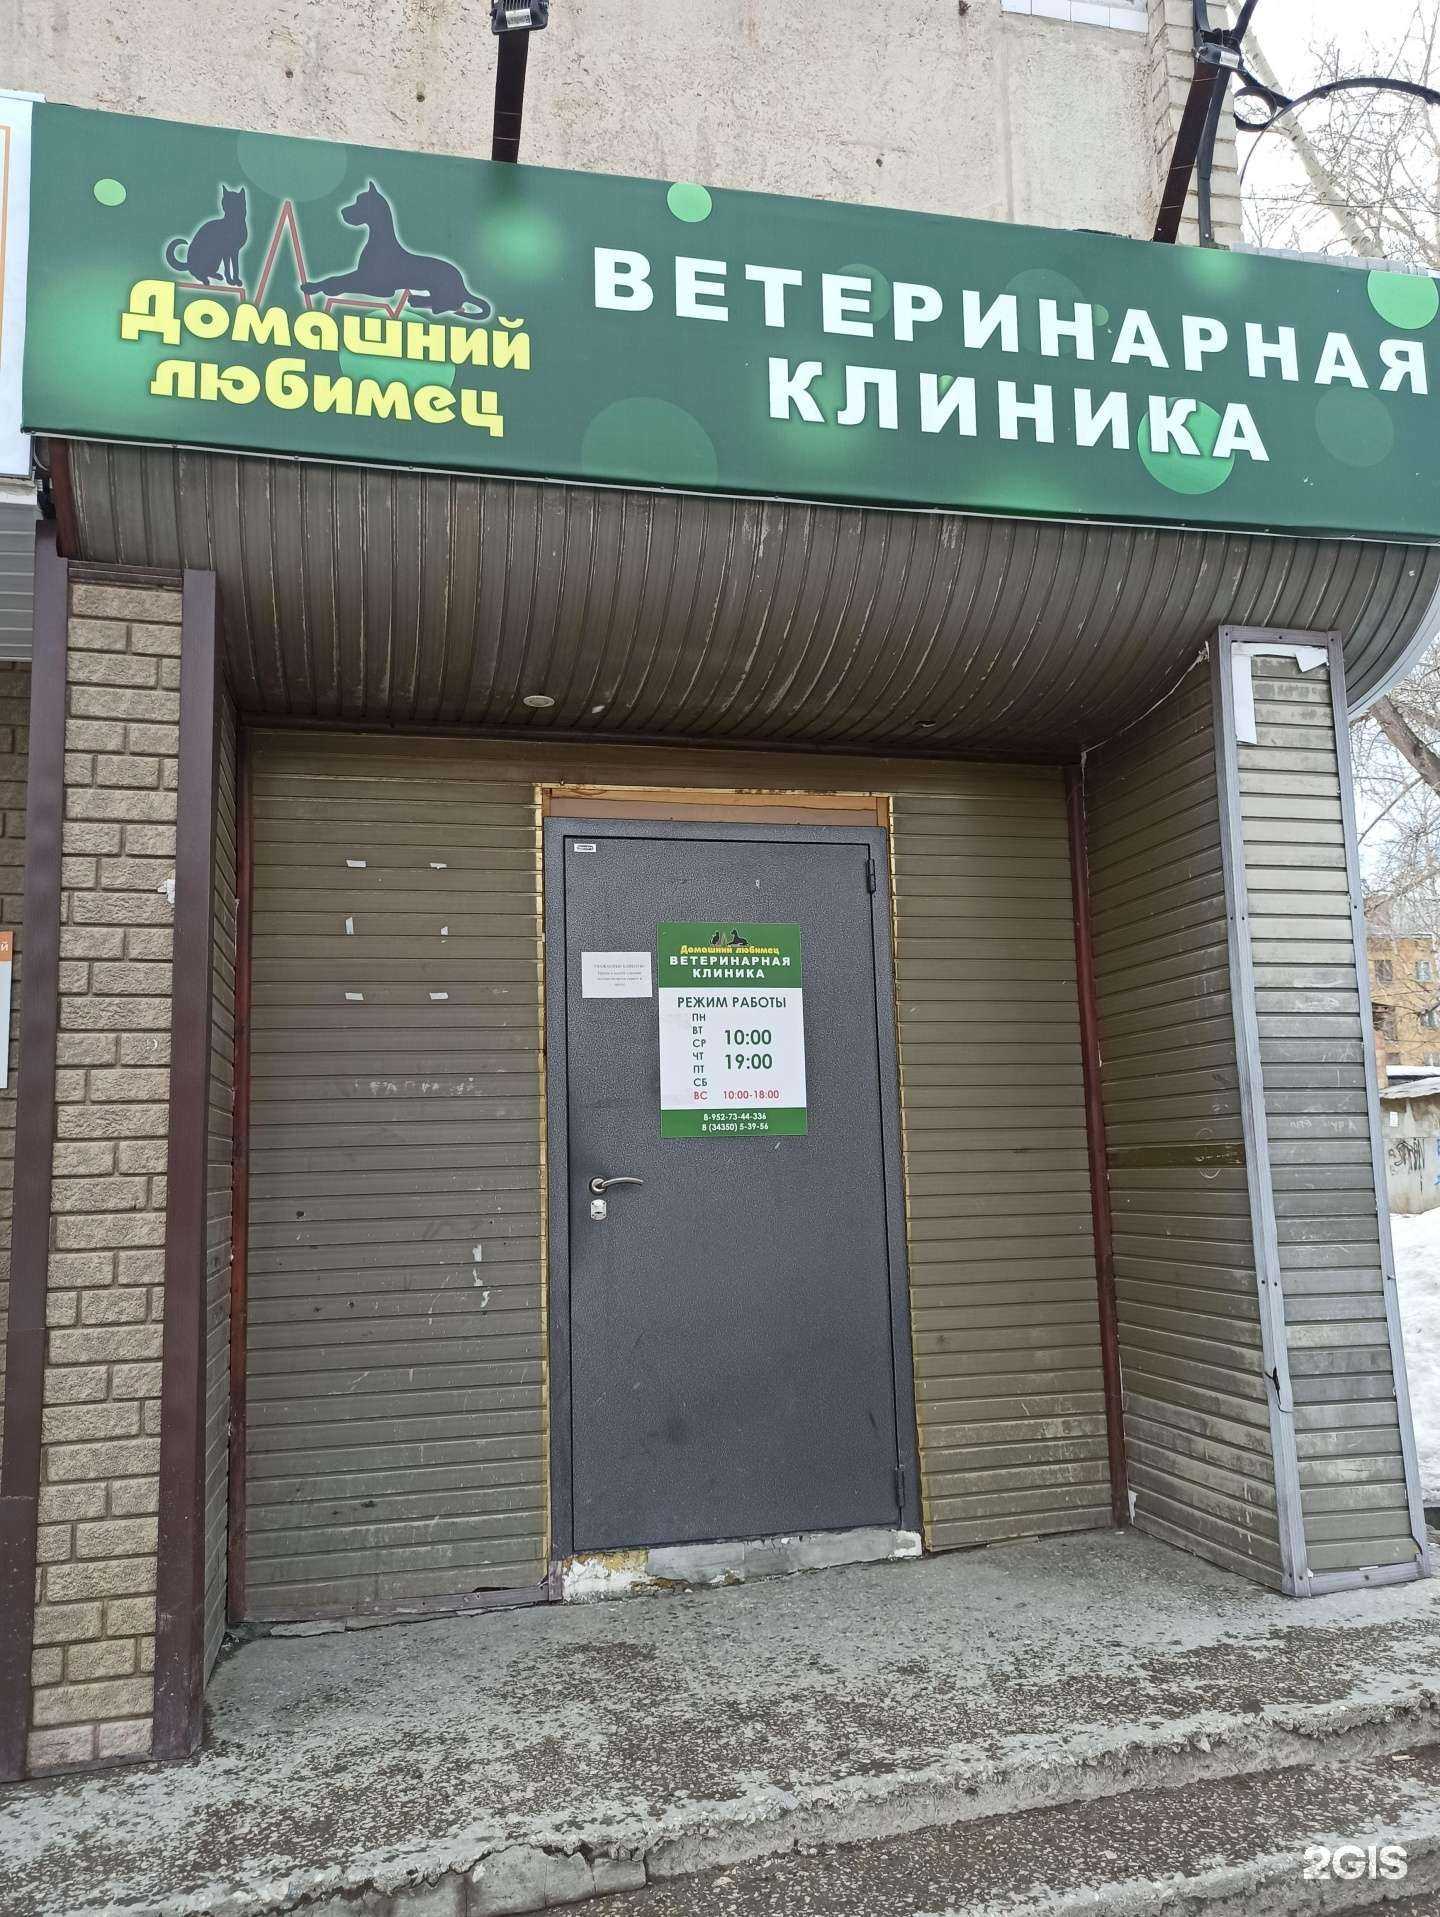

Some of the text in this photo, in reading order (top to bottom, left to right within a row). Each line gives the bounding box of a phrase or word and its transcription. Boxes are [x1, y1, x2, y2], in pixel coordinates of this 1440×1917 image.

[120, 279, 531, 371] Домашний
[593, 246, 1428, 395] ВЕТЕРИНАРНАЯ
[150, 356, 504, 437] любимец
[767, 356, 1270, 463] КЛИНИКА
[680, 945, 780, 955] Домашний любимец
[669, 956, 791, 966] ВЕТЕРИНАРНАЯ
[692, 968, 765, 978] КЛИНИКА
[677, 997, 786, 1008] РЕЖИМ РАБОТЫ
[692, 1013, 706, 1022] ПН
[692, 1026, 703, 1035] ВТ
[724, 1029, 772, 1045] 10:00
[692, 1039, 706, 1048] СР
[692, 1052, 704, 1061] ЧТ
[725, 1053, 773, 1069] 19:00
[693, 1065, 705, 1074] ПТ
[693, 1078, 708, 1087] СБ
[693, 1090, 780, 1100] ВС 10:00-18:00
